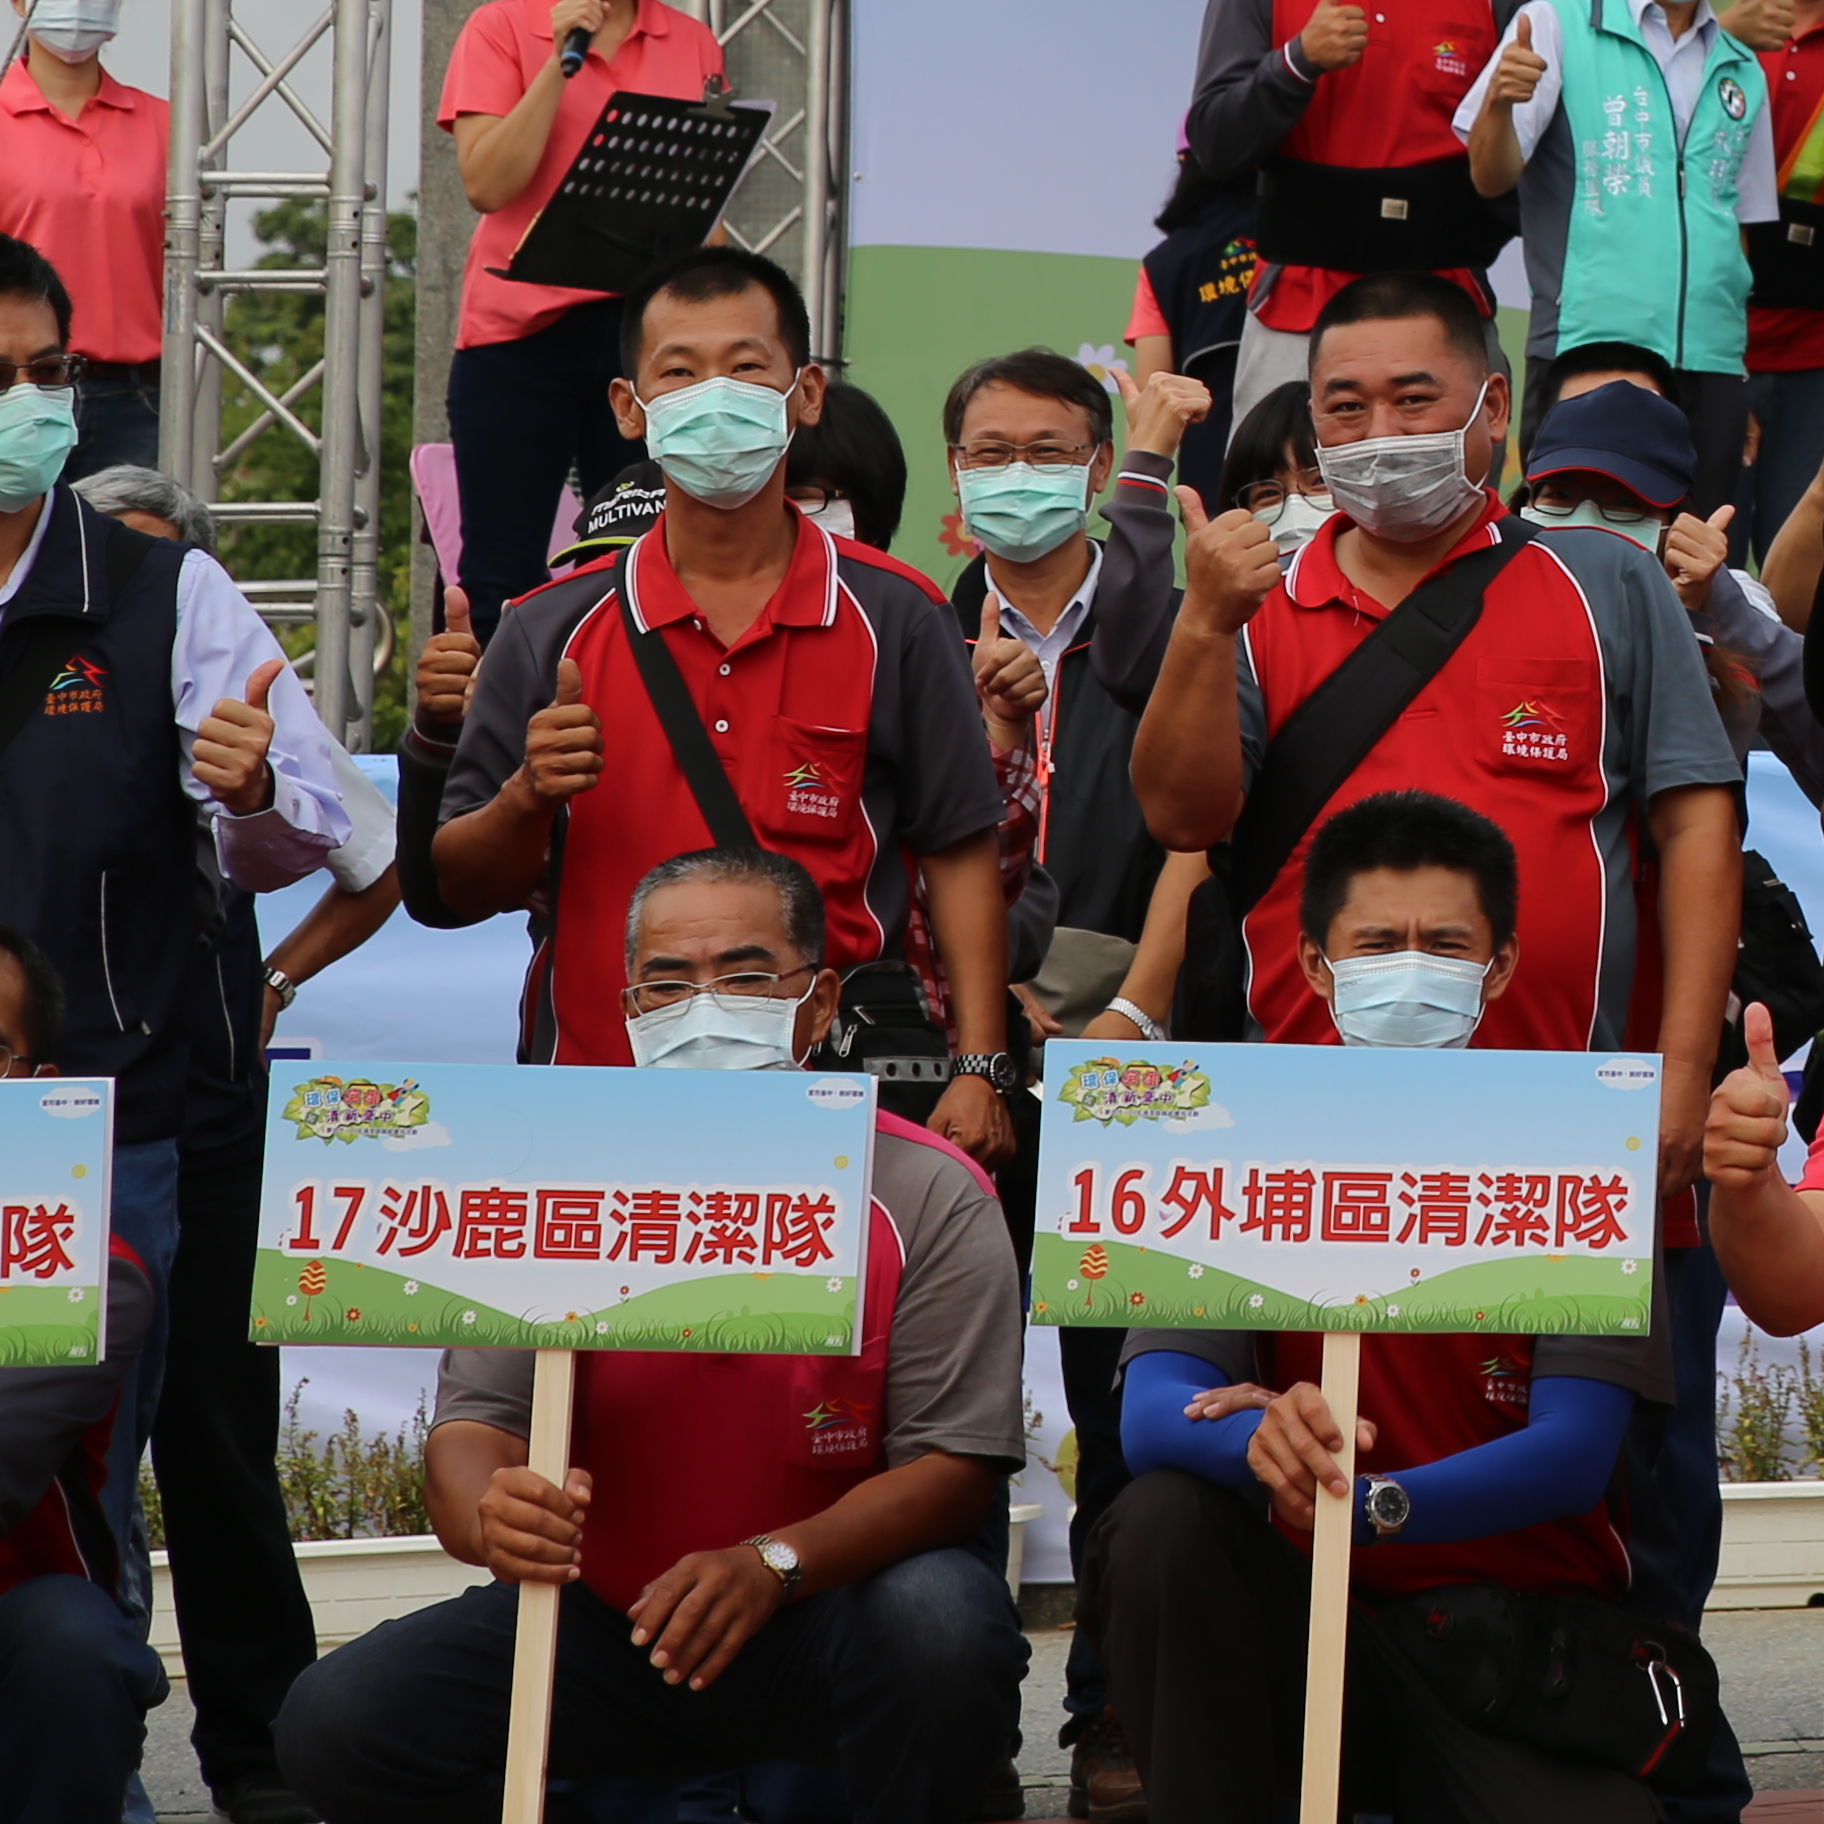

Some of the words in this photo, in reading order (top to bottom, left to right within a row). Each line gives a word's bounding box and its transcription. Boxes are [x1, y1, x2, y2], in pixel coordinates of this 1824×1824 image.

[1502, 731, 1567, 747] 臺中市政府
[1502, 743, 1568, 761] 環境保護局
[0, 1204, 75, 1280] 隊
[288, 1184, 837, 1267] 17沙鹿區清潔隊
[1068, 1165, 1629, 1248] 16外埔區清潔隊
